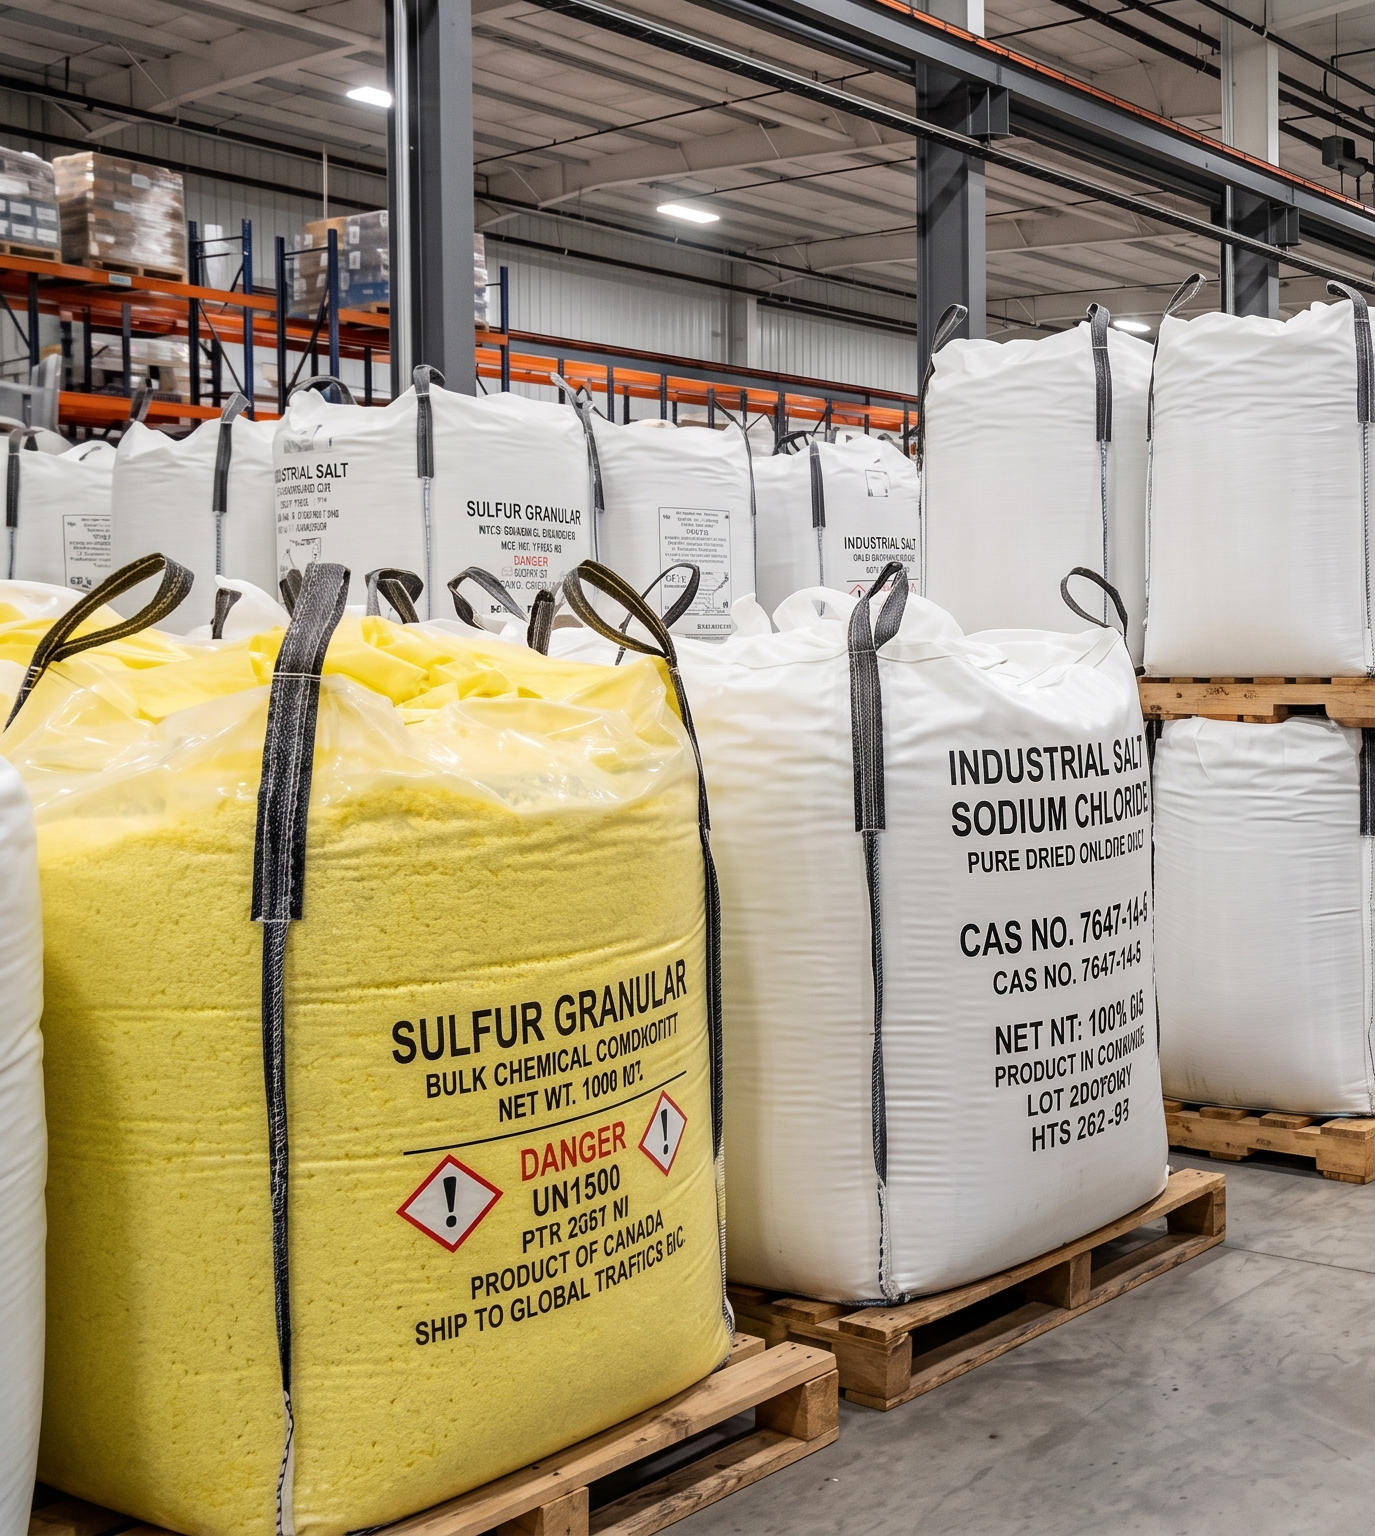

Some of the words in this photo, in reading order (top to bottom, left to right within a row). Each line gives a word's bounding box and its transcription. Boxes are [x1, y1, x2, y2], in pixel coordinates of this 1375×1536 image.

[316, 462, 349, 479] SALT
[466, 500, 522, 520] SULFUR
[525, 504, 581, 526] GRANULAR
[513, 555, 549, 567] DANGER
[844, 536, 900, 550] INDUSTRIAL
[901, 537, 916, 551] SALT
[949, 742, 1110, 785] INDUSTRIAL
[1113, 735, 1142, 774] SALT
[951, 796, 1067, 837] SODIUM
[1075, 781, 1149, 828] CHLORIDE
[967, 850, 1020, 874] PURE
[1026, 845, 1075, 870] DRIED
[960, 920, 1022, 958] CAS
[1031, 916, 1074, 951] NO.
[993, 967, 1037, 995] CAS
[1044, 962, 1077, 989] NO.
[391, 1001, 545, 1065] SULFUR
[554, 958, 687, 1035] GRANULAR
[995, 1021, 1043, 1055] NET
[1051, 1013, 1082, 1047] NT:
[1088, 999, 1127, 1036] 100%
[426, 1066, 487, 1099] BULK
[494, 1043, 592, 1088] CHEMICAL
[995, 1053, 1077, 1088] PRODUCT
[1080, 1048, 1093, 1072] IN
[499, 1091, 538, 1122] NET
[544, 1083, 577, 1112] WT.
[1027, 1088, 1065, 1117] LOT
[520, 1121, 627, 1181] DANGER
[1031, 1120, 1071, 1152] HTS
[533, 1164, 620, 1216] UN1500
[471, 1250, 570, 1300] PRODUCT
[576, 1240, 598, 1268] OF
[604, 1209, 664, 1257] CANADA
[522, 1222, 562, 1253] PTR
[415, 1312, 467, 1346] SHIP
[474, 1304, 504, 1332] TO
[510, 1278, 590, 1322] GLOBAL
